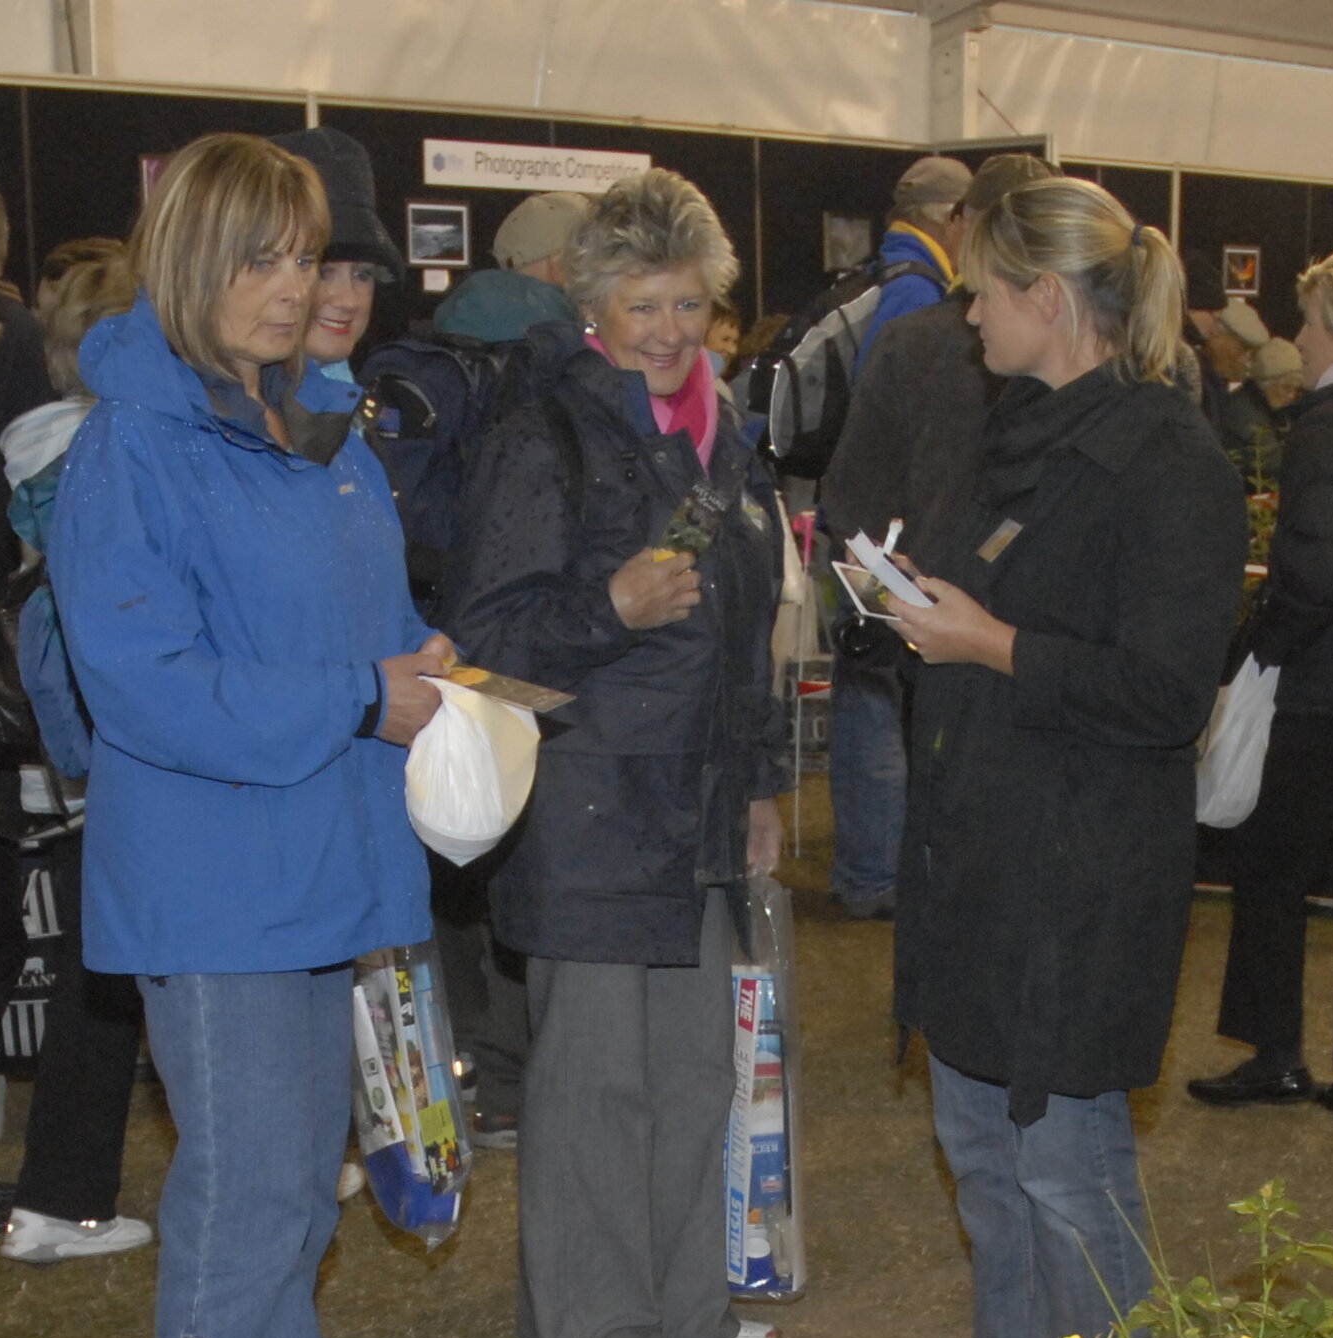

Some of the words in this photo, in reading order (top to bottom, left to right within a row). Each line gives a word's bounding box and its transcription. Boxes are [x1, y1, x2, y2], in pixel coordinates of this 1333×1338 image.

[474, 151, 562, 181] Photographic
[740, 989, 754, 1023] THE
[729, 1199, 743, 1268] SYSTEM
